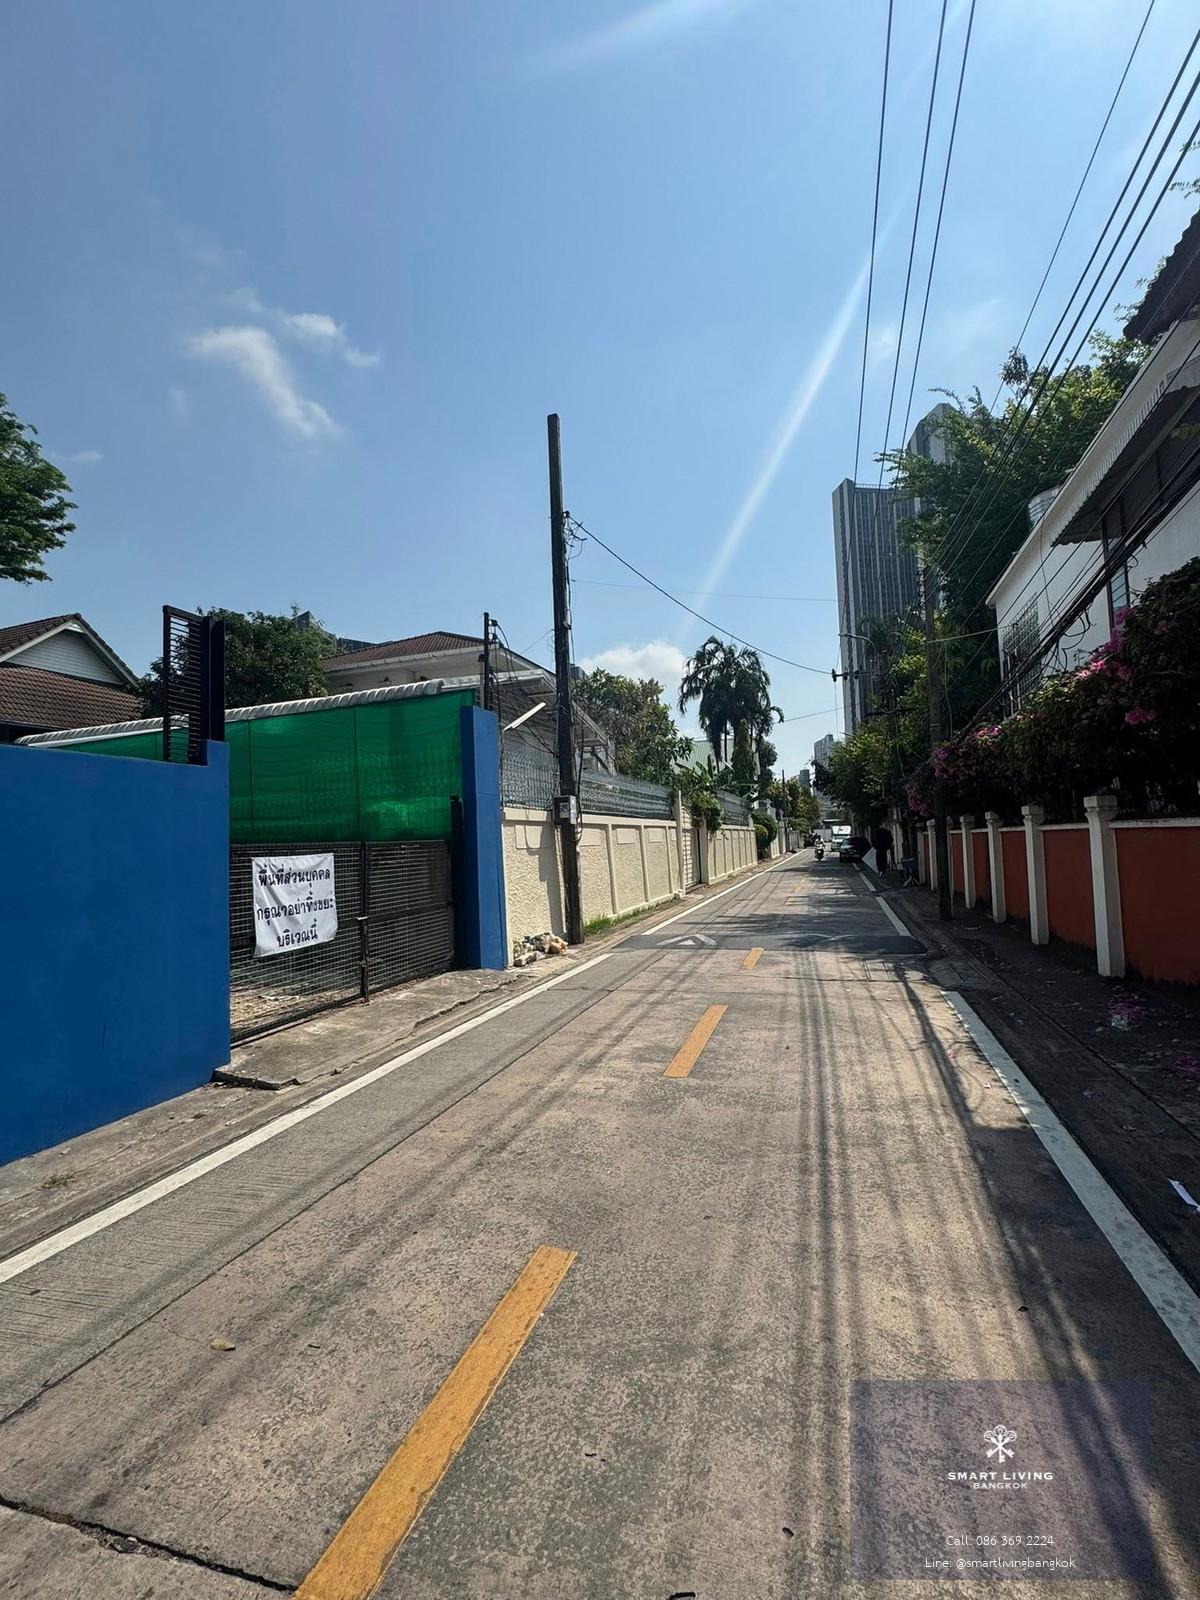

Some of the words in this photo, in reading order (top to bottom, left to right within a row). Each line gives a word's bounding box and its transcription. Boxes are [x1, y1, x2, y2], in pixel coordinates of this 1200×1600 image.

[258, 863, 331, 888] พื้นที่ส่วนบุคคล
[256, 890, 334, 926] กรุณาอย่าทิ้งขยะ
[276, 918, 318, 947] บริเวณนี้
